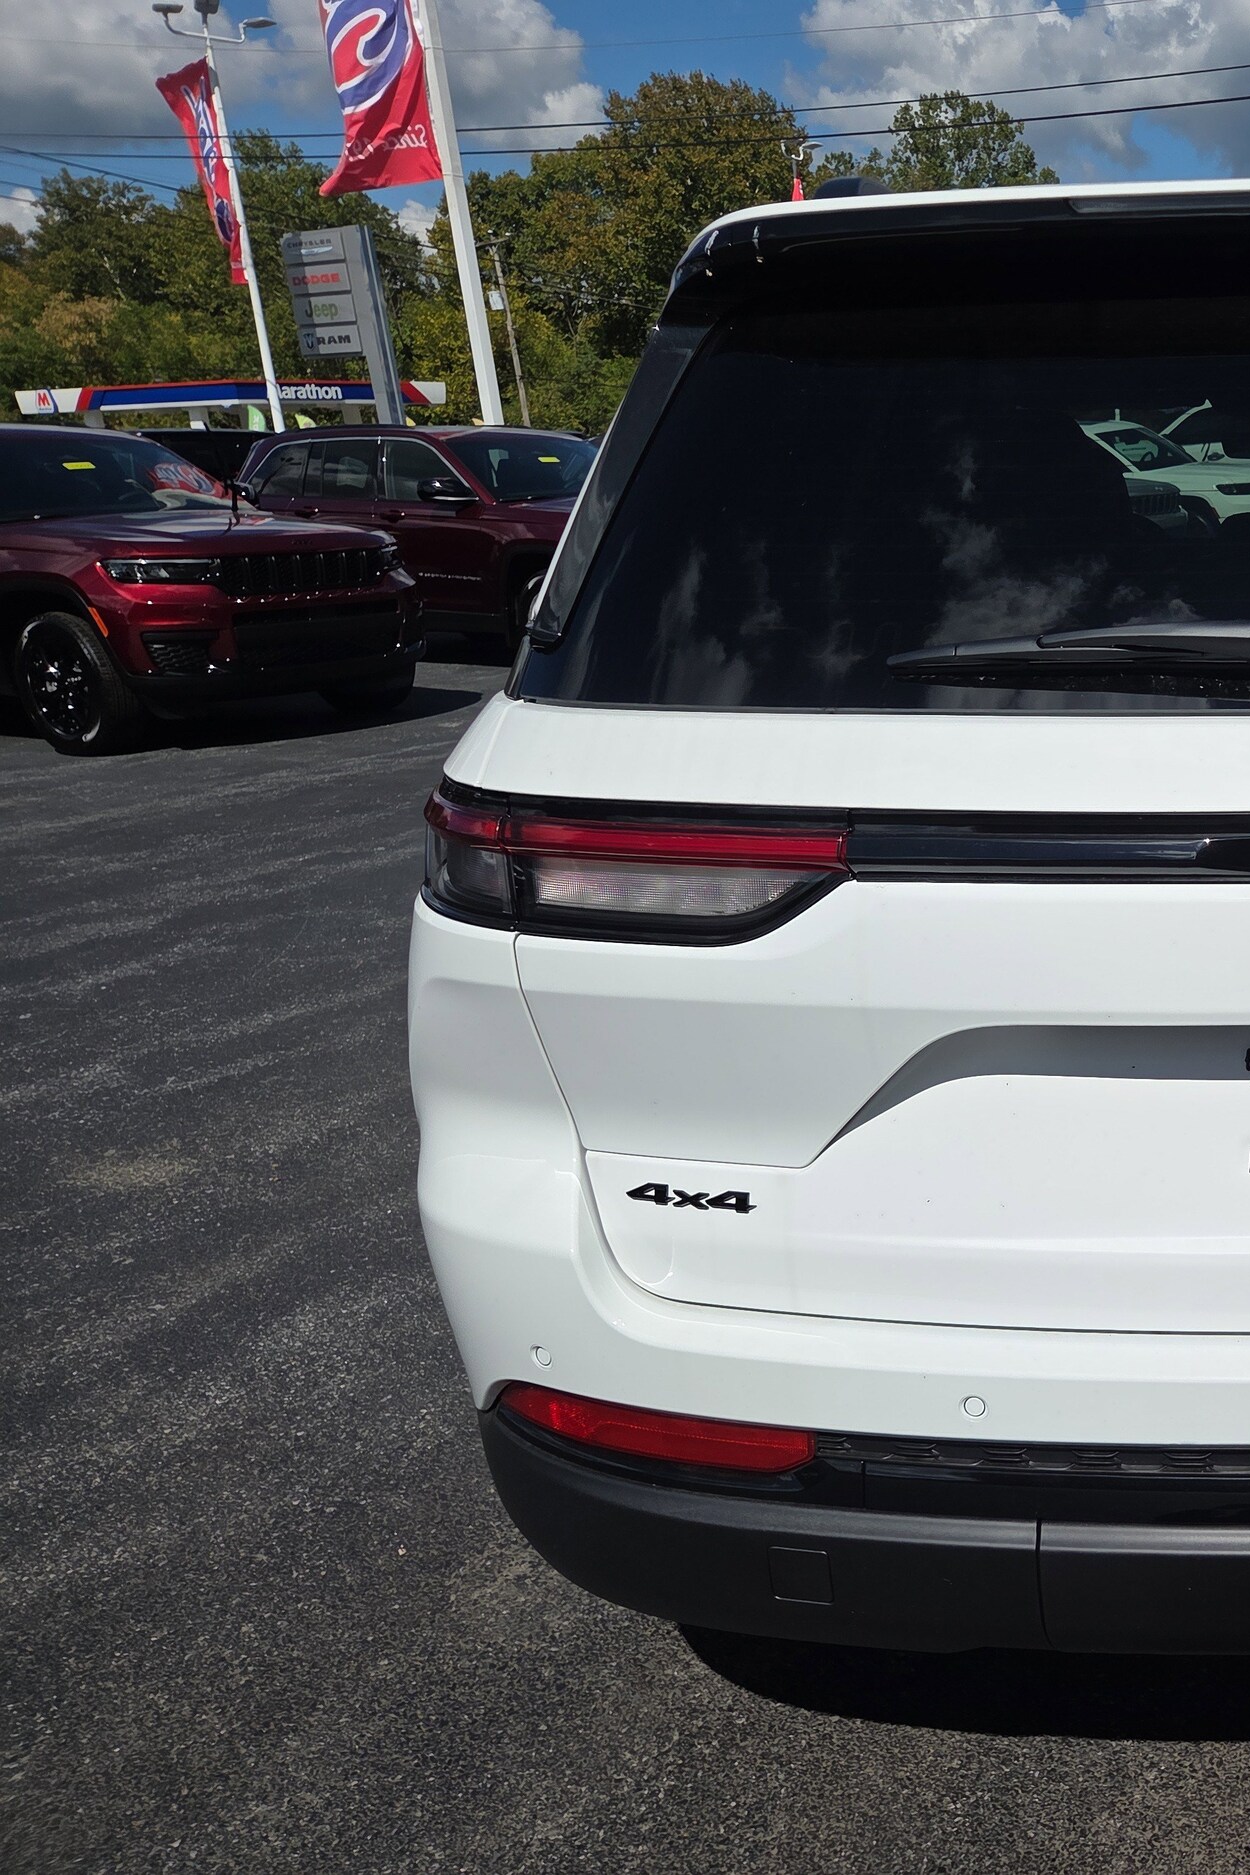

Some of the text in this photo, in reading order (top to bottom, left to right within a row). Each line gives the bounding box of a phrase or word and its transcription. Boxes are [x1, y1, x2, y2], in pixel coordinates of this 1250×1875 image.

[287, 239, 332, 249] CHRYSLER
[292, 272, 340, 287] DODGE
[305, 299, 338, 320] Jeep
[316, 334, 351, 346] RAM
[38, 392, 50, 407] M
[626, 1182, 757, 1214] 4x4
